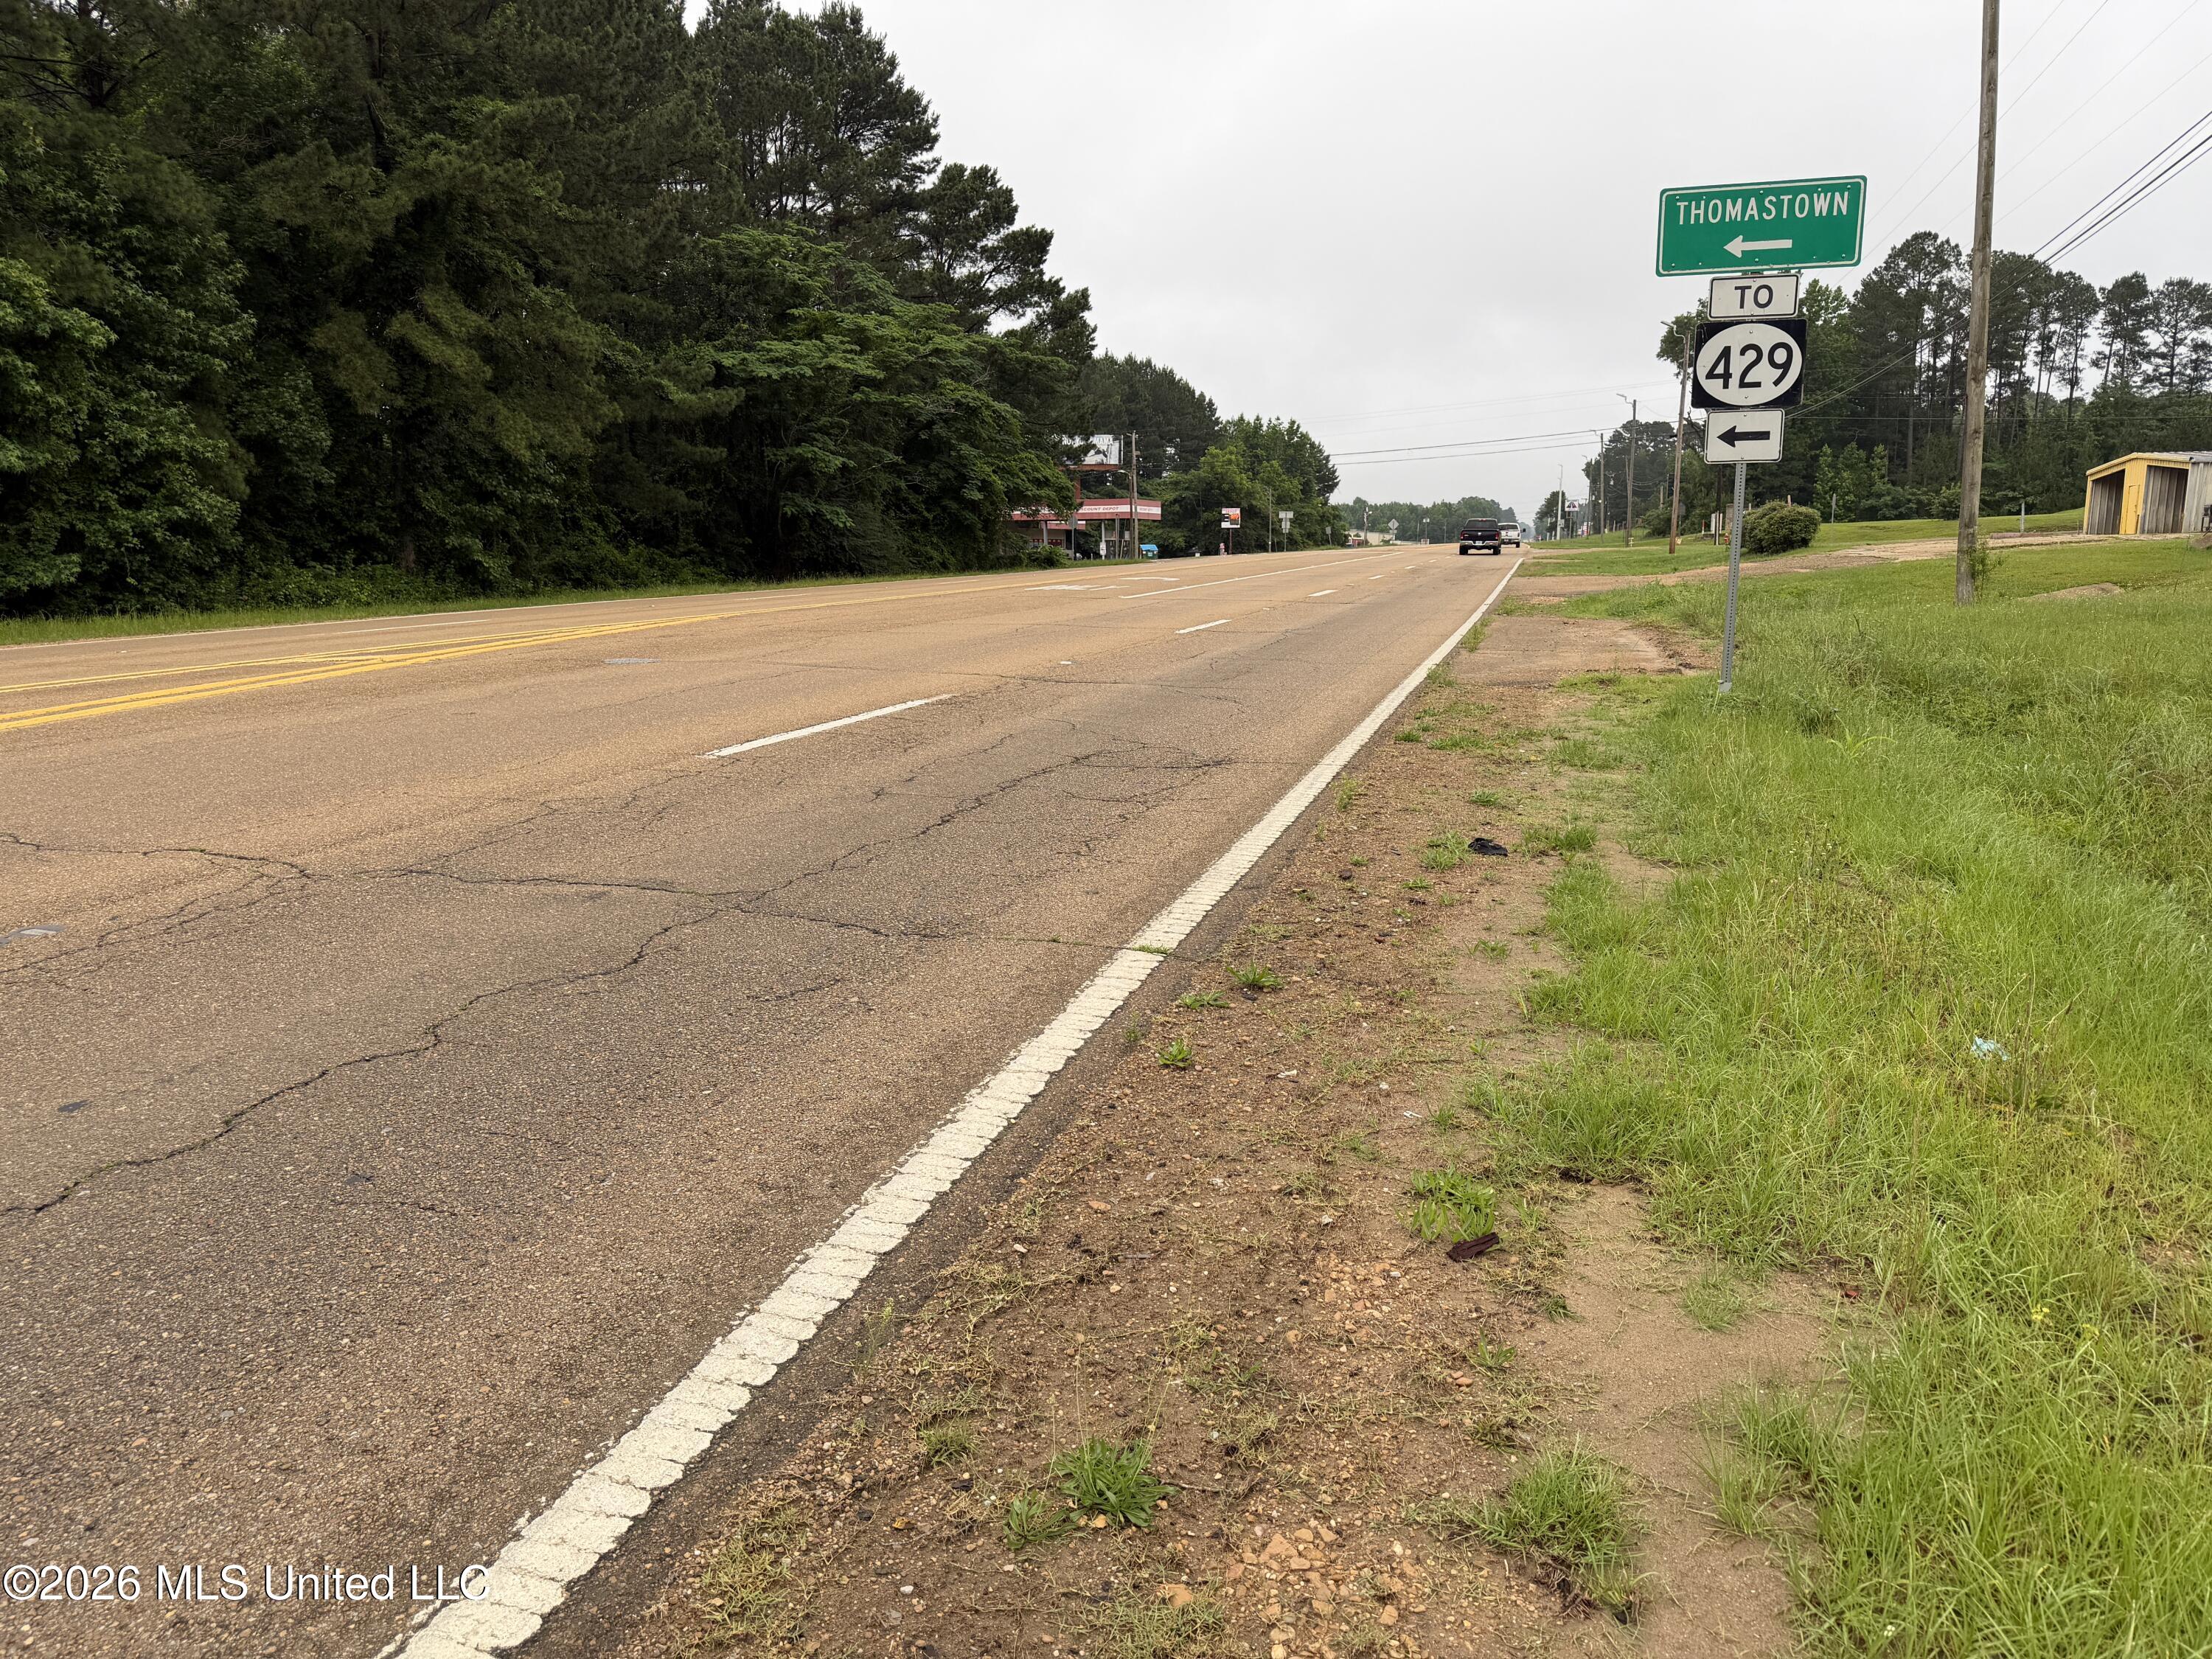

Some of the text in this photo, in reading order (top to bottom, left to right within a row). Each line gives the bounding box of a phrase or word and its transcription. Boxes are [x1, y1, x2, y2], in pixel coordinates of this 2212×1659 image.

[1676, 191, 1849, 225] THOMASTOWN
[1734, 284, 1774, 309] TO
[1705, 341, 1794, 390] 429
